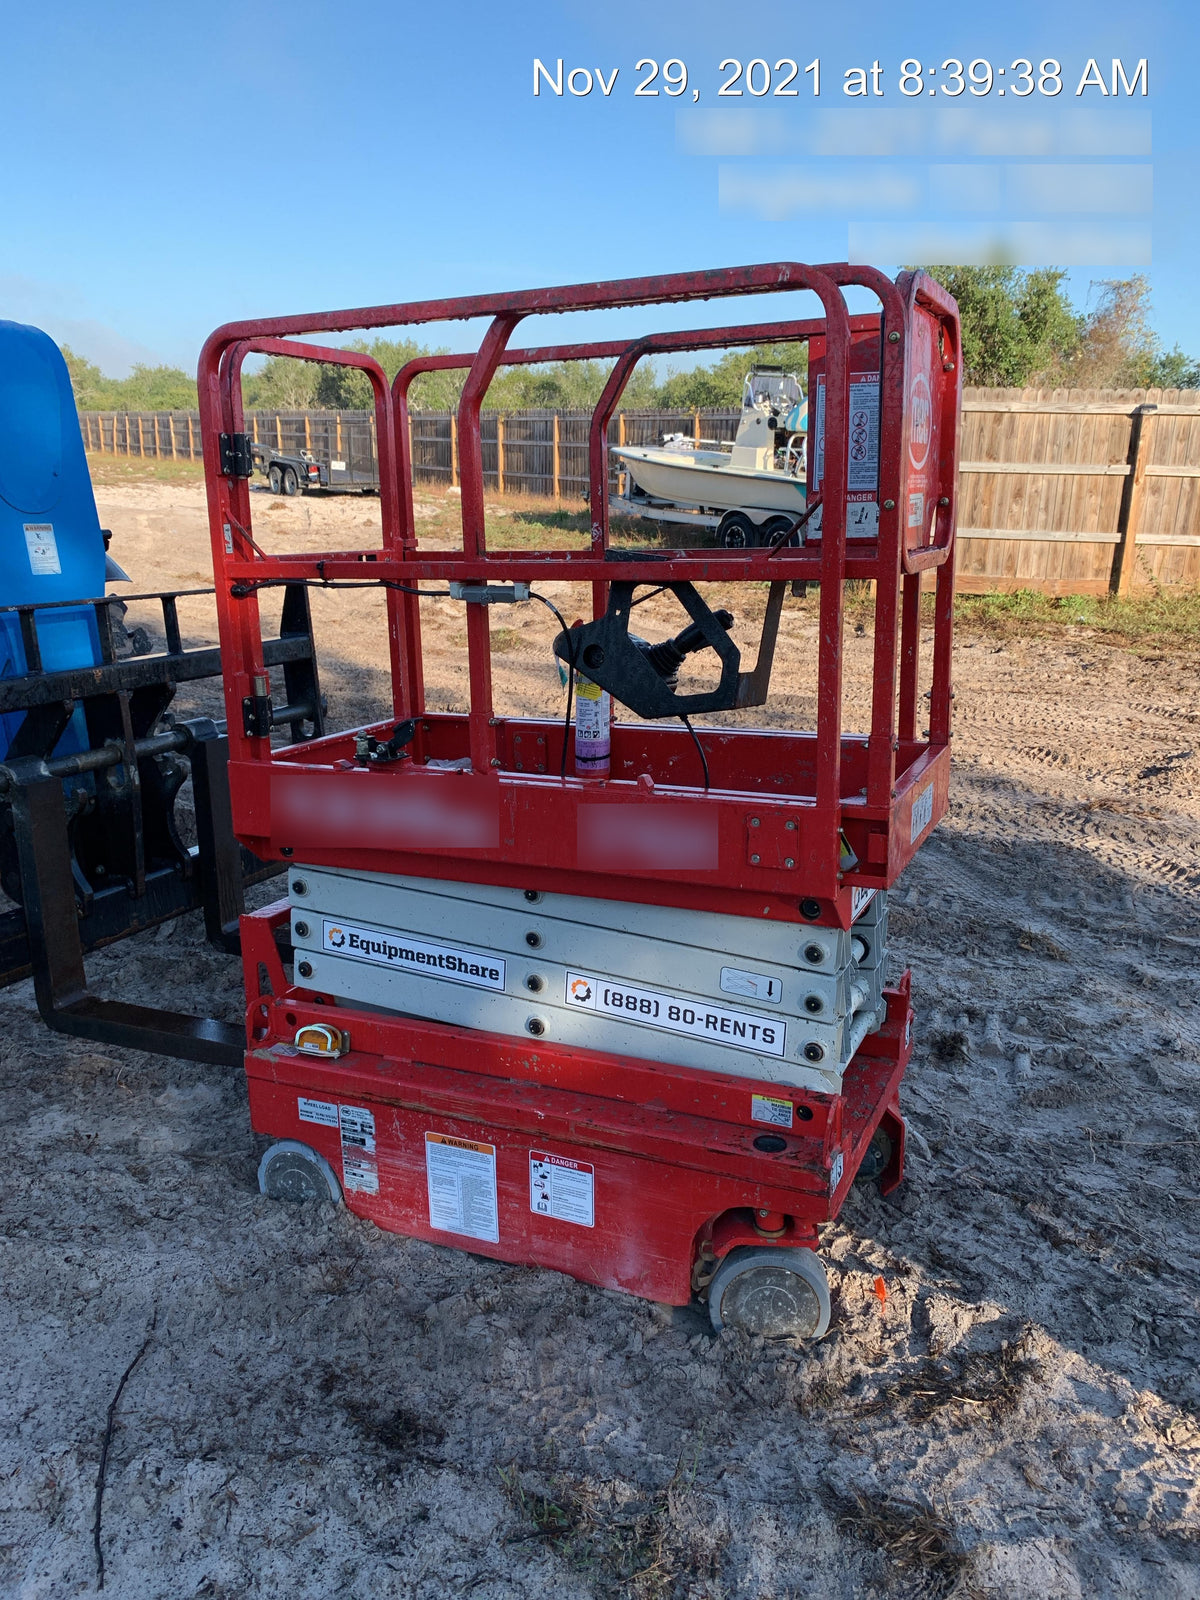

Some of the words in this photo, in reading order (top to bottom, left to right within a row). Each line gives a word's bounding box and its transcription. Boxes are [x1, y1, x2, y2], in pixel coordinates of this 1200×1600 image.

[847, 493, 873, 502] ANGER
[348, 933, 500, 981] EquipmentShare
[603, 988, 660, 1018] (888)
[668, 1005, 776, 1044] 80-RENTS
[447, 1140, 479, 1151] WARNING
[551, 1157, 578, 1169] DANGER
